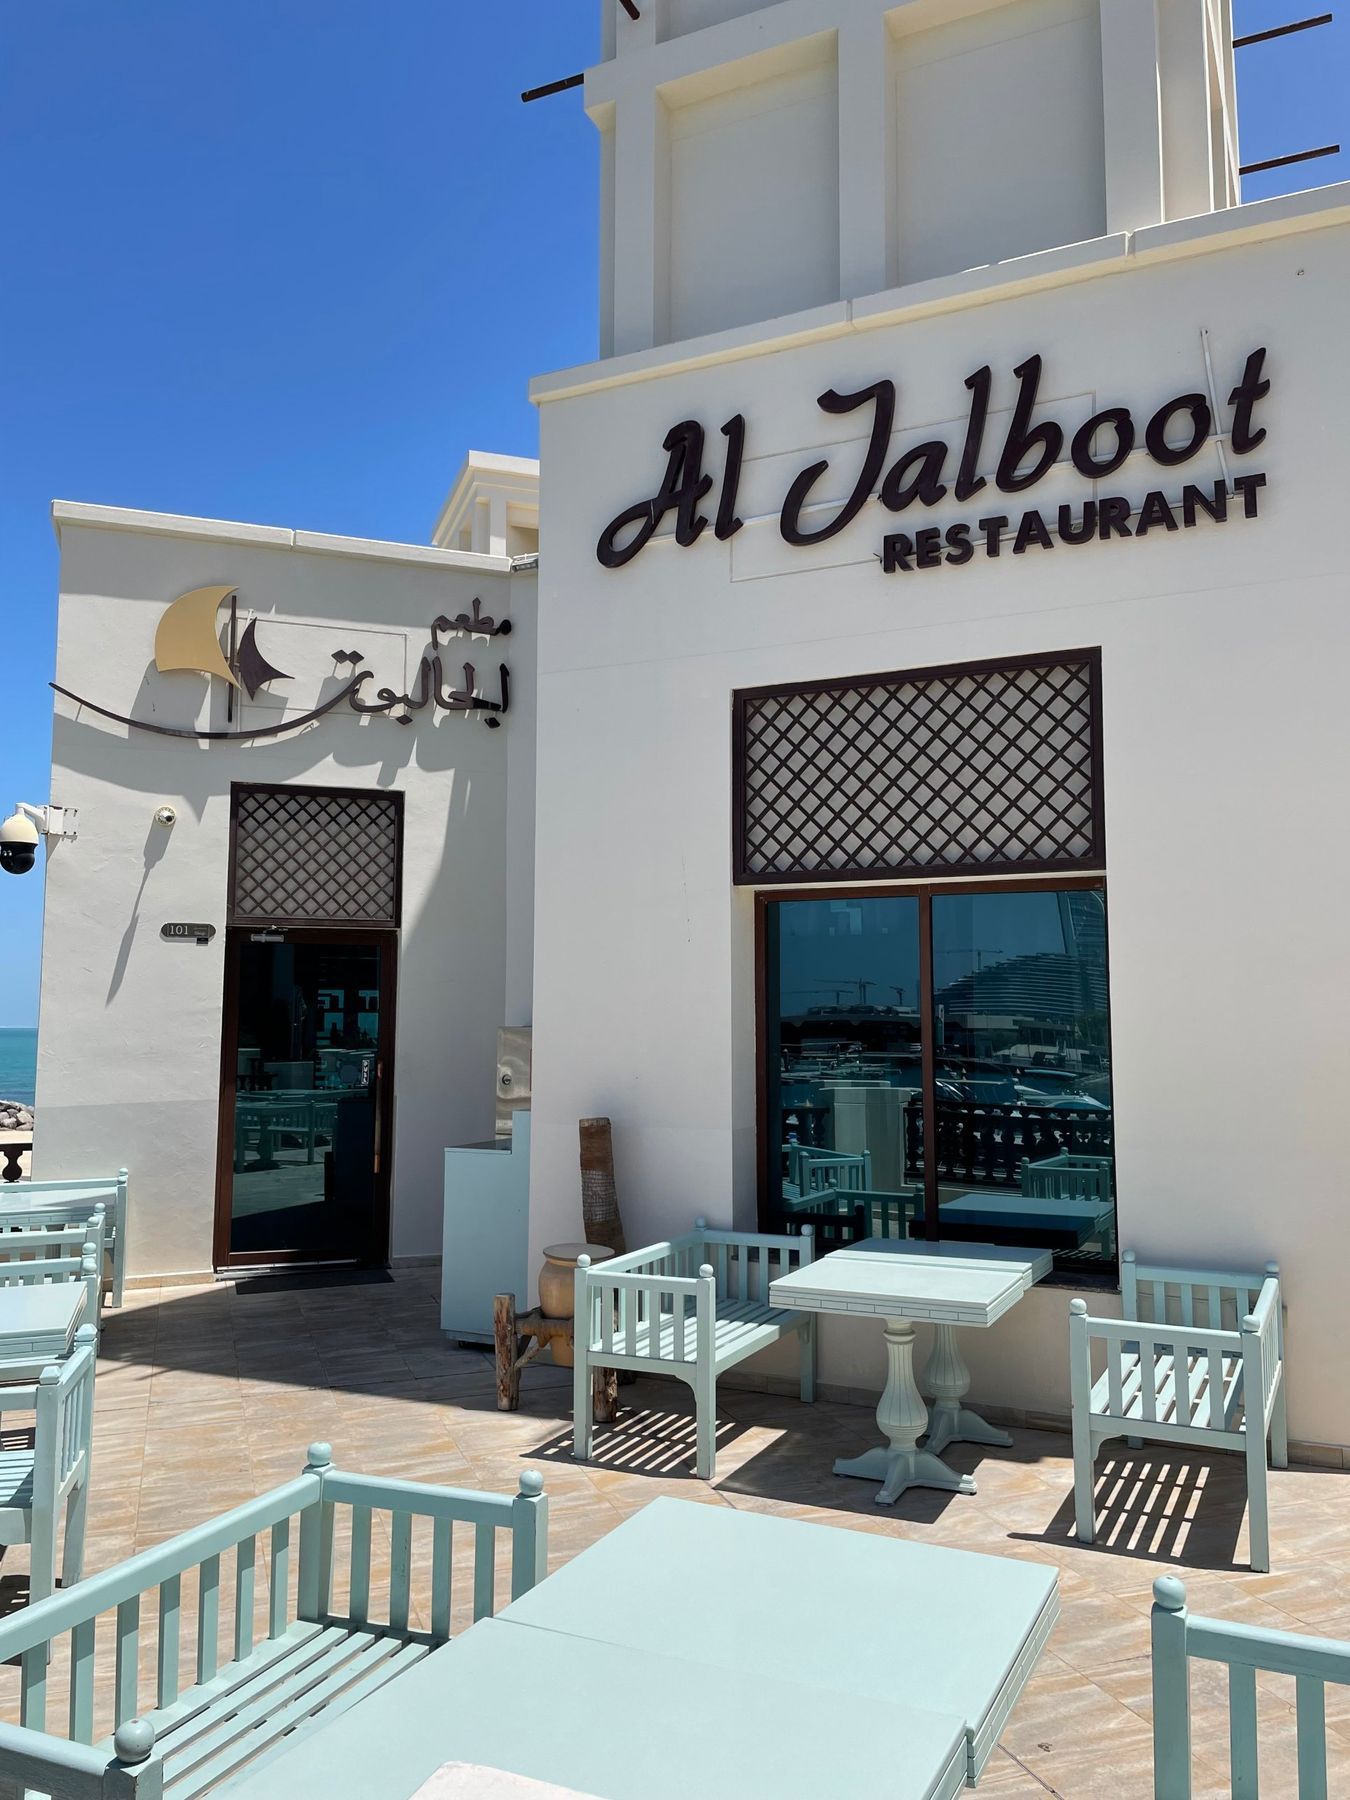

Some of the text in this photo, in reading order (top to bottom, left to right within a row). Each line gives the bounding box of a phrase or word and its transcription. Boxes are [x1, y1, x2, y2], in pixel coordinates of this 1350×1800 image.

[597, 346, 1271, 568] Al Jalboot
[882, 472, 1267, 574] RESTAURANT
[431, 597, 512, 650] مطعم
[169, 925, 188, 935] 101
